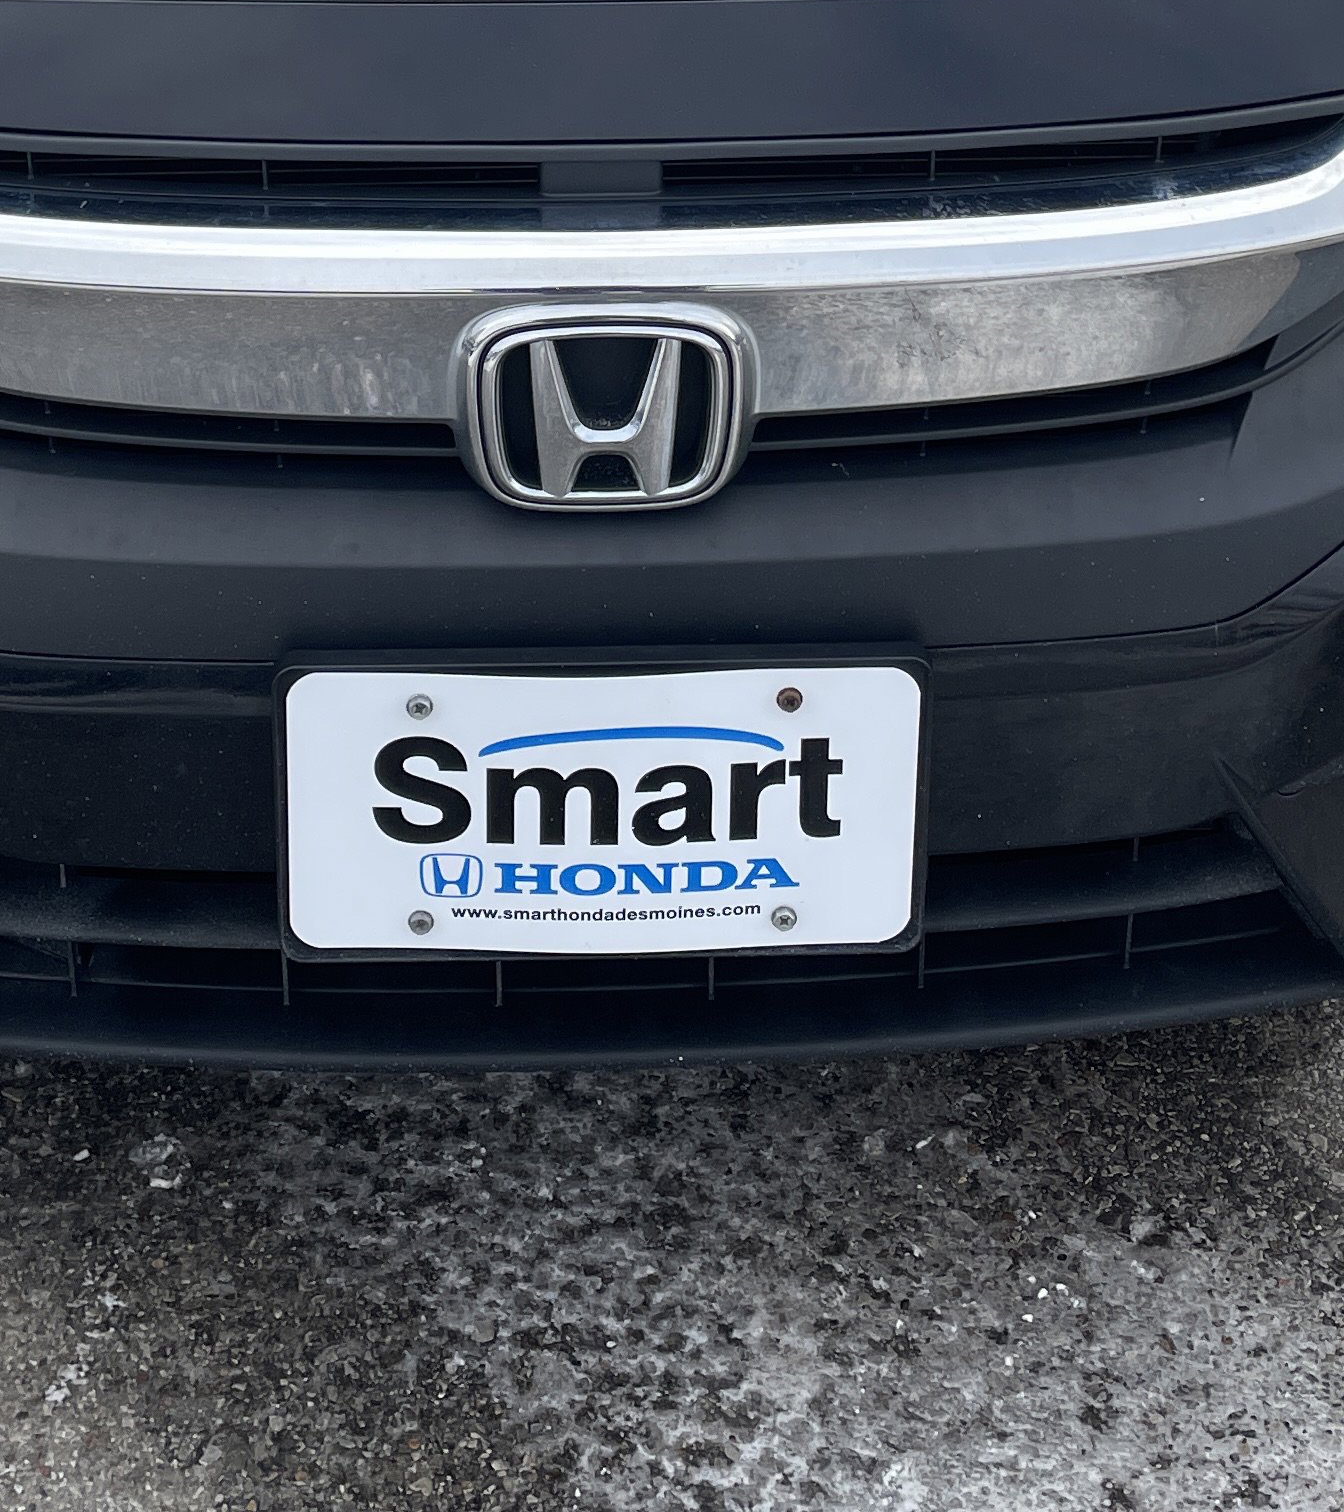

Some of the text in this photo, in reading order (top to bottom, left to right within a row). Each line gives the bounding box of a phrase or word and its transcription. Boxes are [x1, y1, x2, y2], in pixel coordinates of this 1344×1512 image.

[372, 736, 843, 847] Smart
[494, 857, 800, 896] HONDA
[451, 901, 761, 922] www.smarthondadesmoines.com
